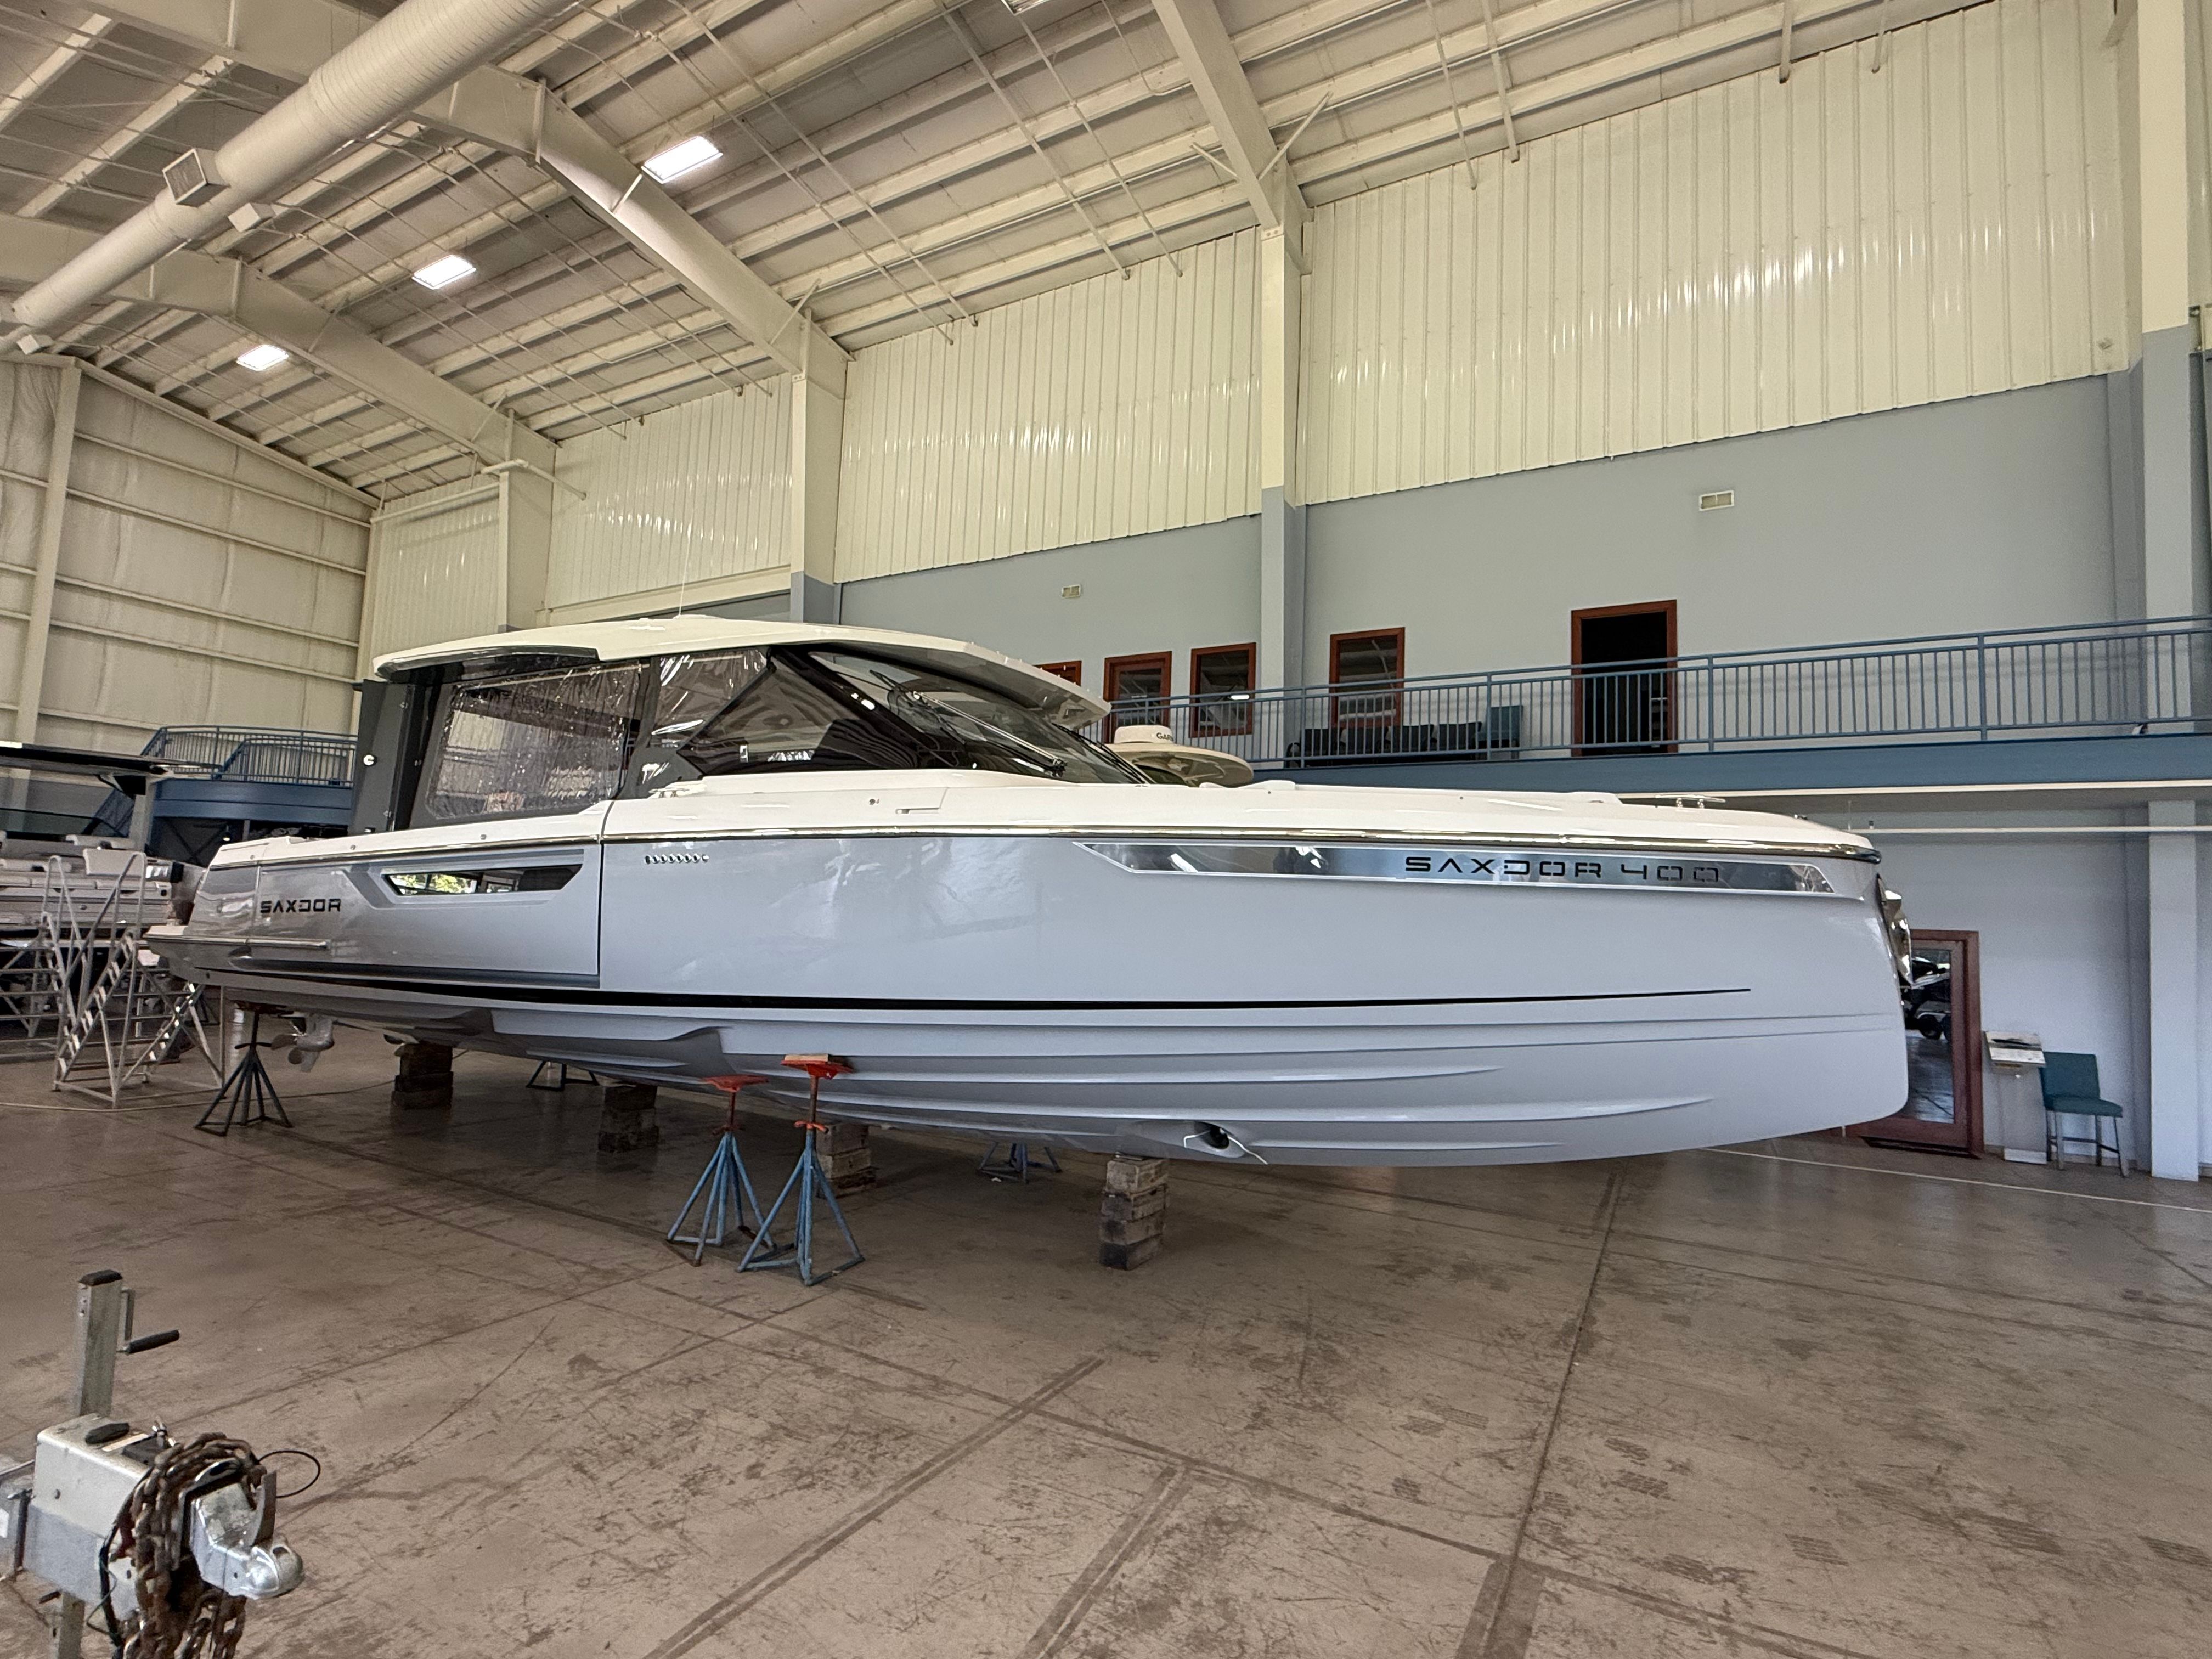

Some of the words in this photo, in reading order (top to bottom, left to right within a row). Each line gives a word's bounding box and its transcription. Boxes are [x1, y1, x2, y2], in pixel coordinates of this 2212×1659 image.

[1405, 857, 1601, 878] SAXDOR
[1621, 863, 1719, 882] 400
[260, 899, 341, 913] SAXDOR
